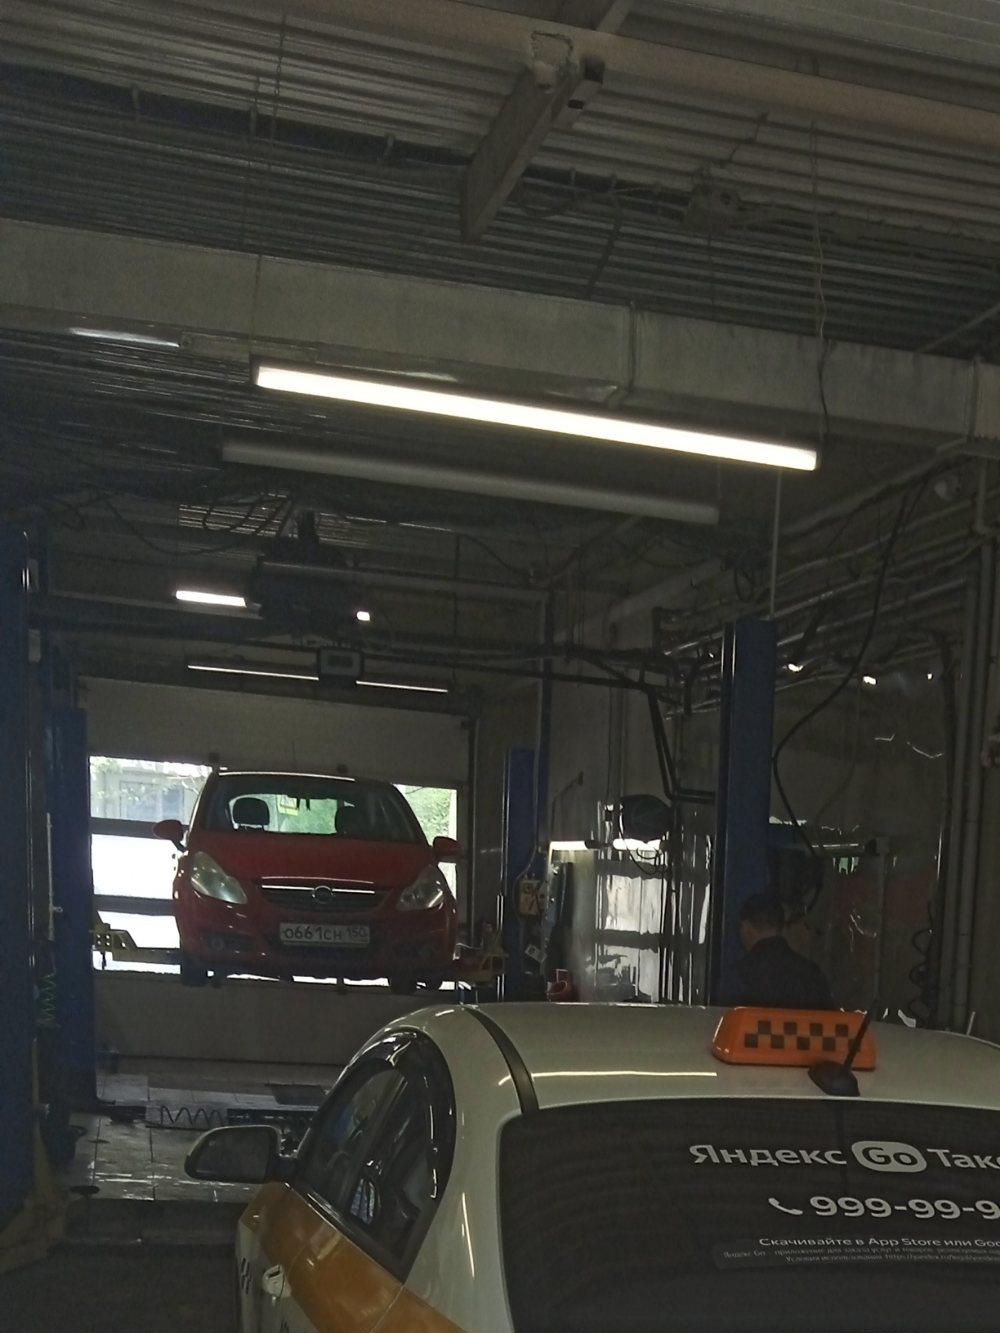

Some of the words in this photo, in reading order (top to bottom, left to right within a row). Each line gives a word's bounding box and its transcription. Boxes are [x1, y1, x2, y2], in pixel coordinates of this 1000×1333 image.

[689, 1144, 848, 1168] Яндекс
[858, 1144, 921, 1168] Go
[759, 1237, 852, 1247] Скачивайте
[855, 1238, 865, 1246] в
[868, 1237, 899, 1248] App
[900, 1237, 942, 1247] Store
[944, 1239, 971, 1248] или
